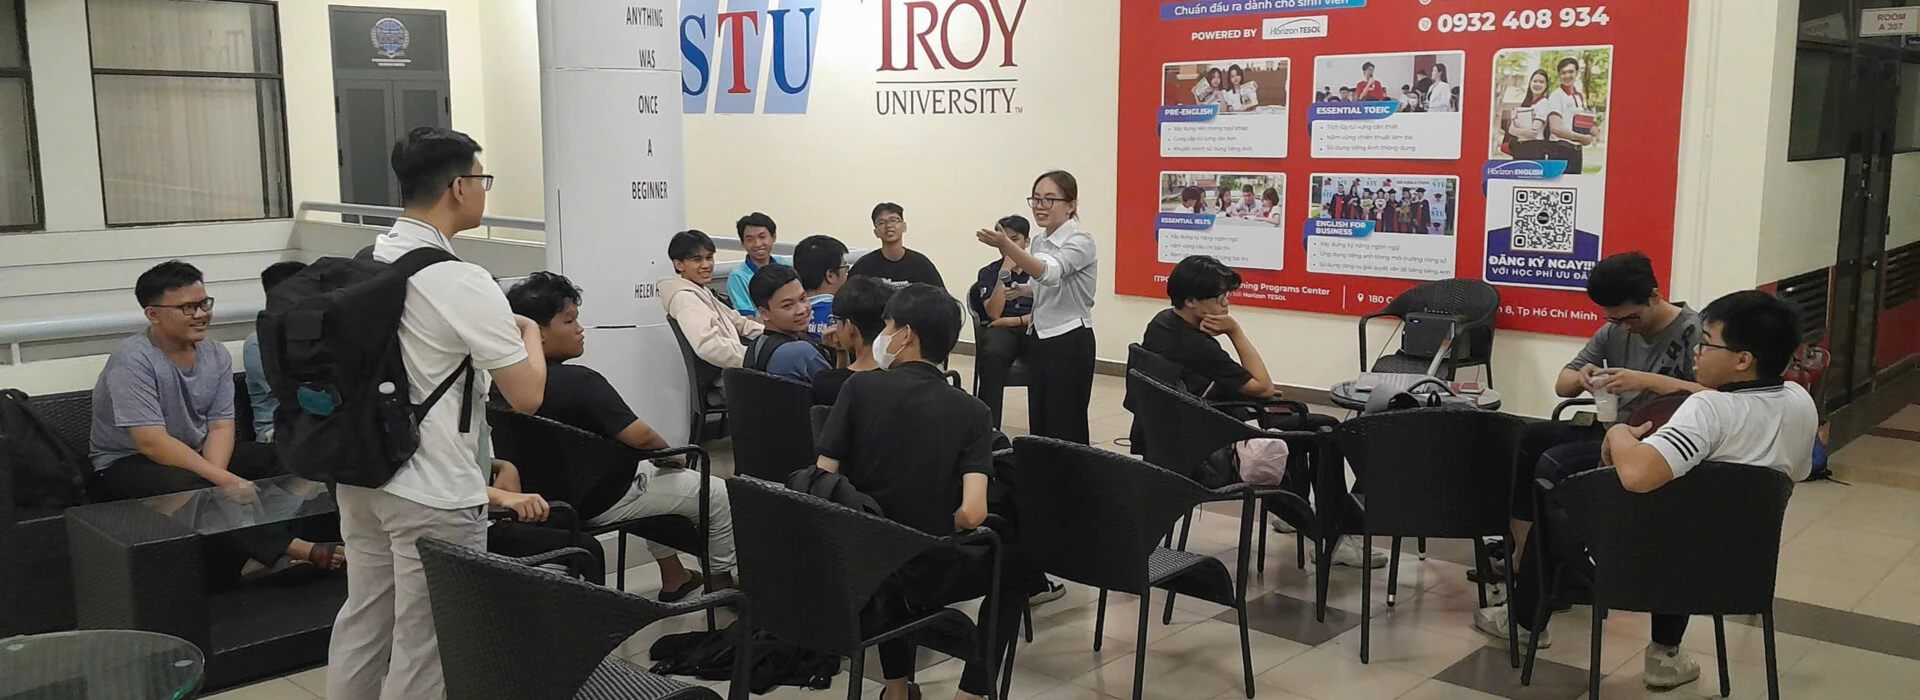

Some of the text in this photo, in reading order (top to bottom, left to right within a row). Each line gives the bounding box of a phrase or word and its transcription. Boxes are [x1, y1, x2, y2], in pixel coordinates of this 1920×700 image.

[1276, 0, 1295, 8] cho
[626, 6, 664, 27] ANYTHING
[1437, 6, 1610, 33] 0932 408 934
[1877, 13, 1906, 21] ROOM
[1191, 28, 1258, 41] POWERED BY
[1270, 25, 1321, 36] Horizon TESOL
[680, 8, 815, 95] STU
[639, 48, 656, 69] WAS
[638, 95, 659, 115] ONCE
[876, 87, 1016, 115] UNIVERSITY
[1164, 107, 1213, 116] PRE-ENGLISH
[1316, 106, 1391, 115] ESSENTIAL TOEIC
[647, 138, 653, 157] A
[1487, 167, 1544, 176] Horizon ENGLISH
[631, 181, 668, 200] BEGINNER
[1160, 217, 1212, 226] ESSENTIAL IELTS
[1315, 220, 1367, 229] ENGLISH FOR
[1315, 227, 1353, 236] BUSINESS
[1488, 254, 1595, 271] ĐĂNG KÝ NGAY!!!
[1491, 267, 1589, 280] VỚI HỌC PHÍ ƯU ĐÃ
[634, 284, 655, 299] HELEN
[1239, 282, 1331, 296] ning Programs Center
[1243, 291, 1266, 299] Horizon
[1267, 293, 1287, 301] TESOL
[1368, 294, 1385, 304] 180
[1505, 305, 1515, 316] 8,
[1517, 306, 1531, 317] Tp
[1532, 307, 1548, 317] Hồ
[1549, 308, 1568, 318] Chí
[1570, 309, 1598, 321] Minh
